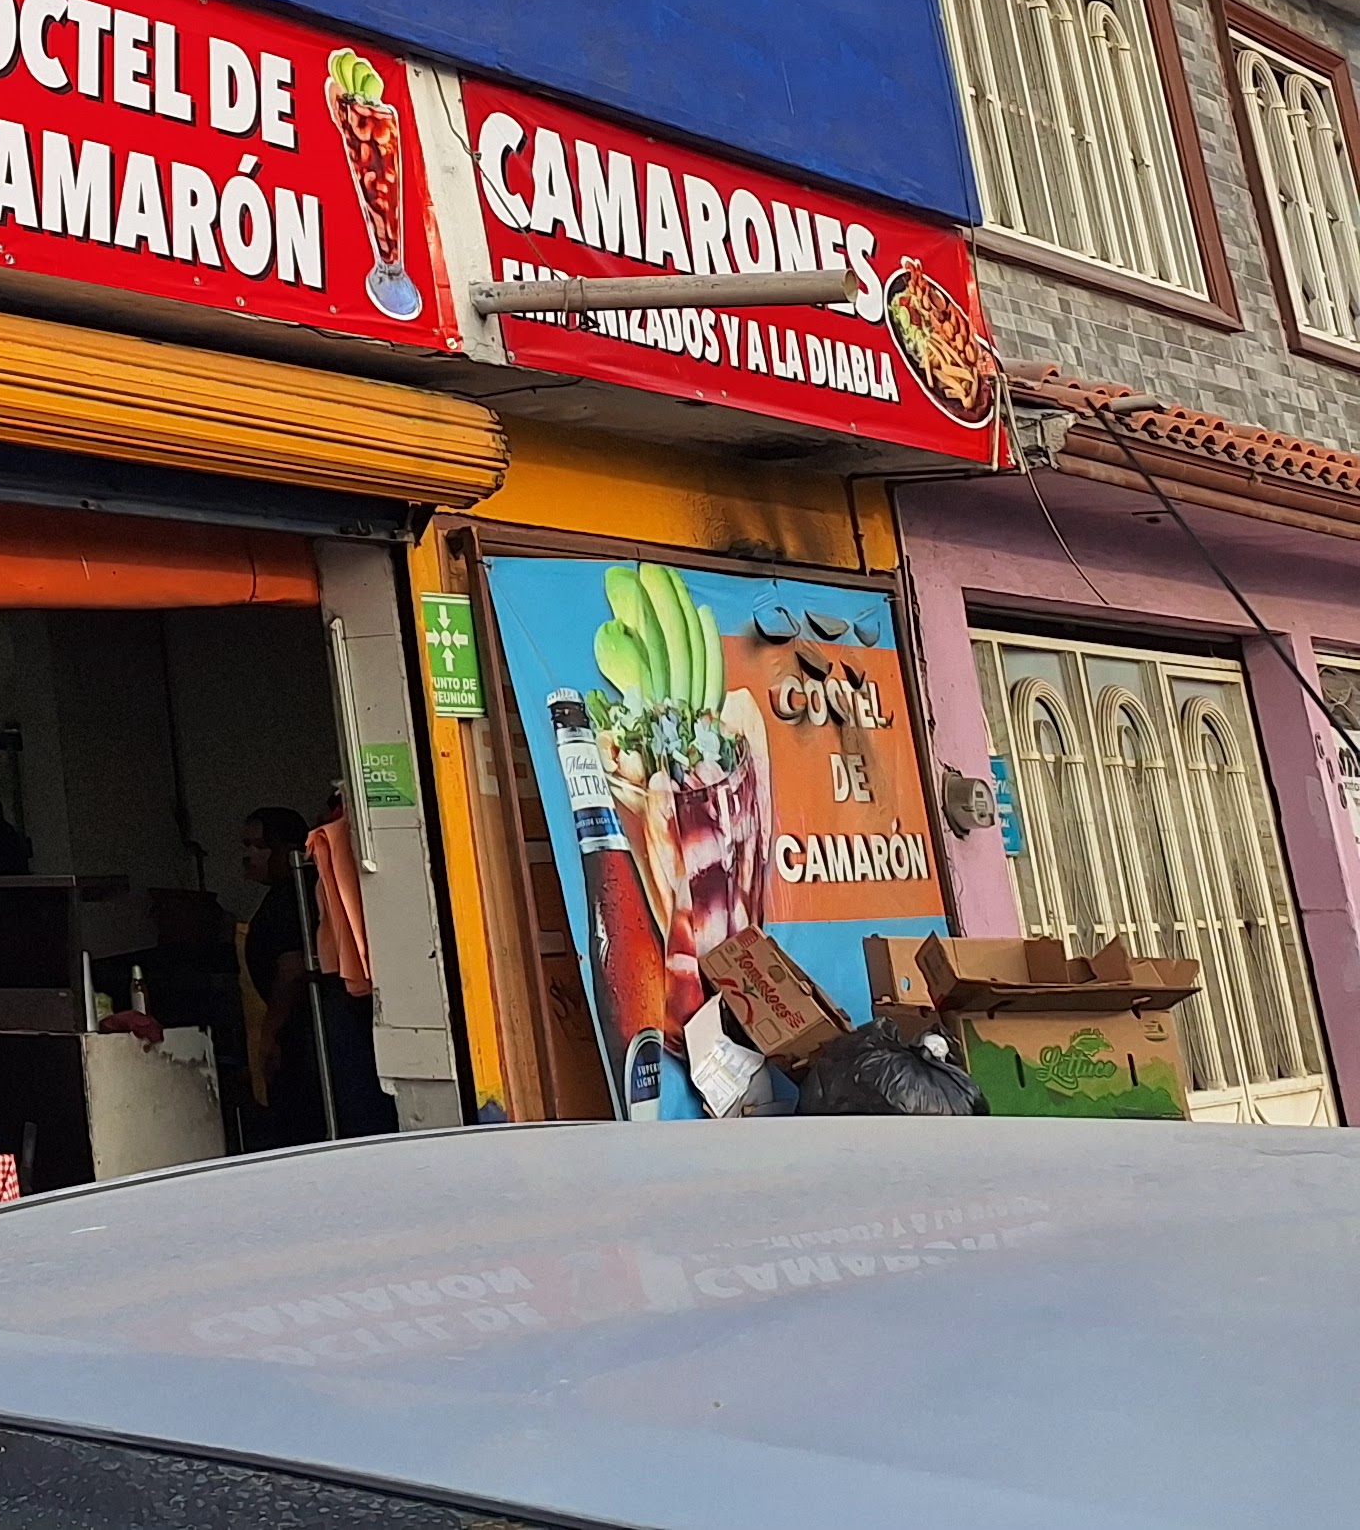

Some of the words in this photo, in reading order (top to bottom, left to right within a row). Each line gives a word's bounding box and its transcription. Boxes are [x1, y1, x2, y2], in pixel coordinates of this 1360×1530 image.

[209, 36, 297, 150] DE
[478, 112, 884, 323] CAMARONES
[720, 313, 740, 367] Y
[747, 319, 768, 374] A
[768, 324, 806, 382] LA
[805, 333, 900, 403] DIABLA
[432, 676, 461, 690] UNTO
[462, 677, 477, 690] DE
[780, 675, 893, 729] COCTEL
[830, 753, 871, 802] DE
[775, 817, 929, 884] CAMARÓN
[637, 1062, 660, 1076] SUPER
